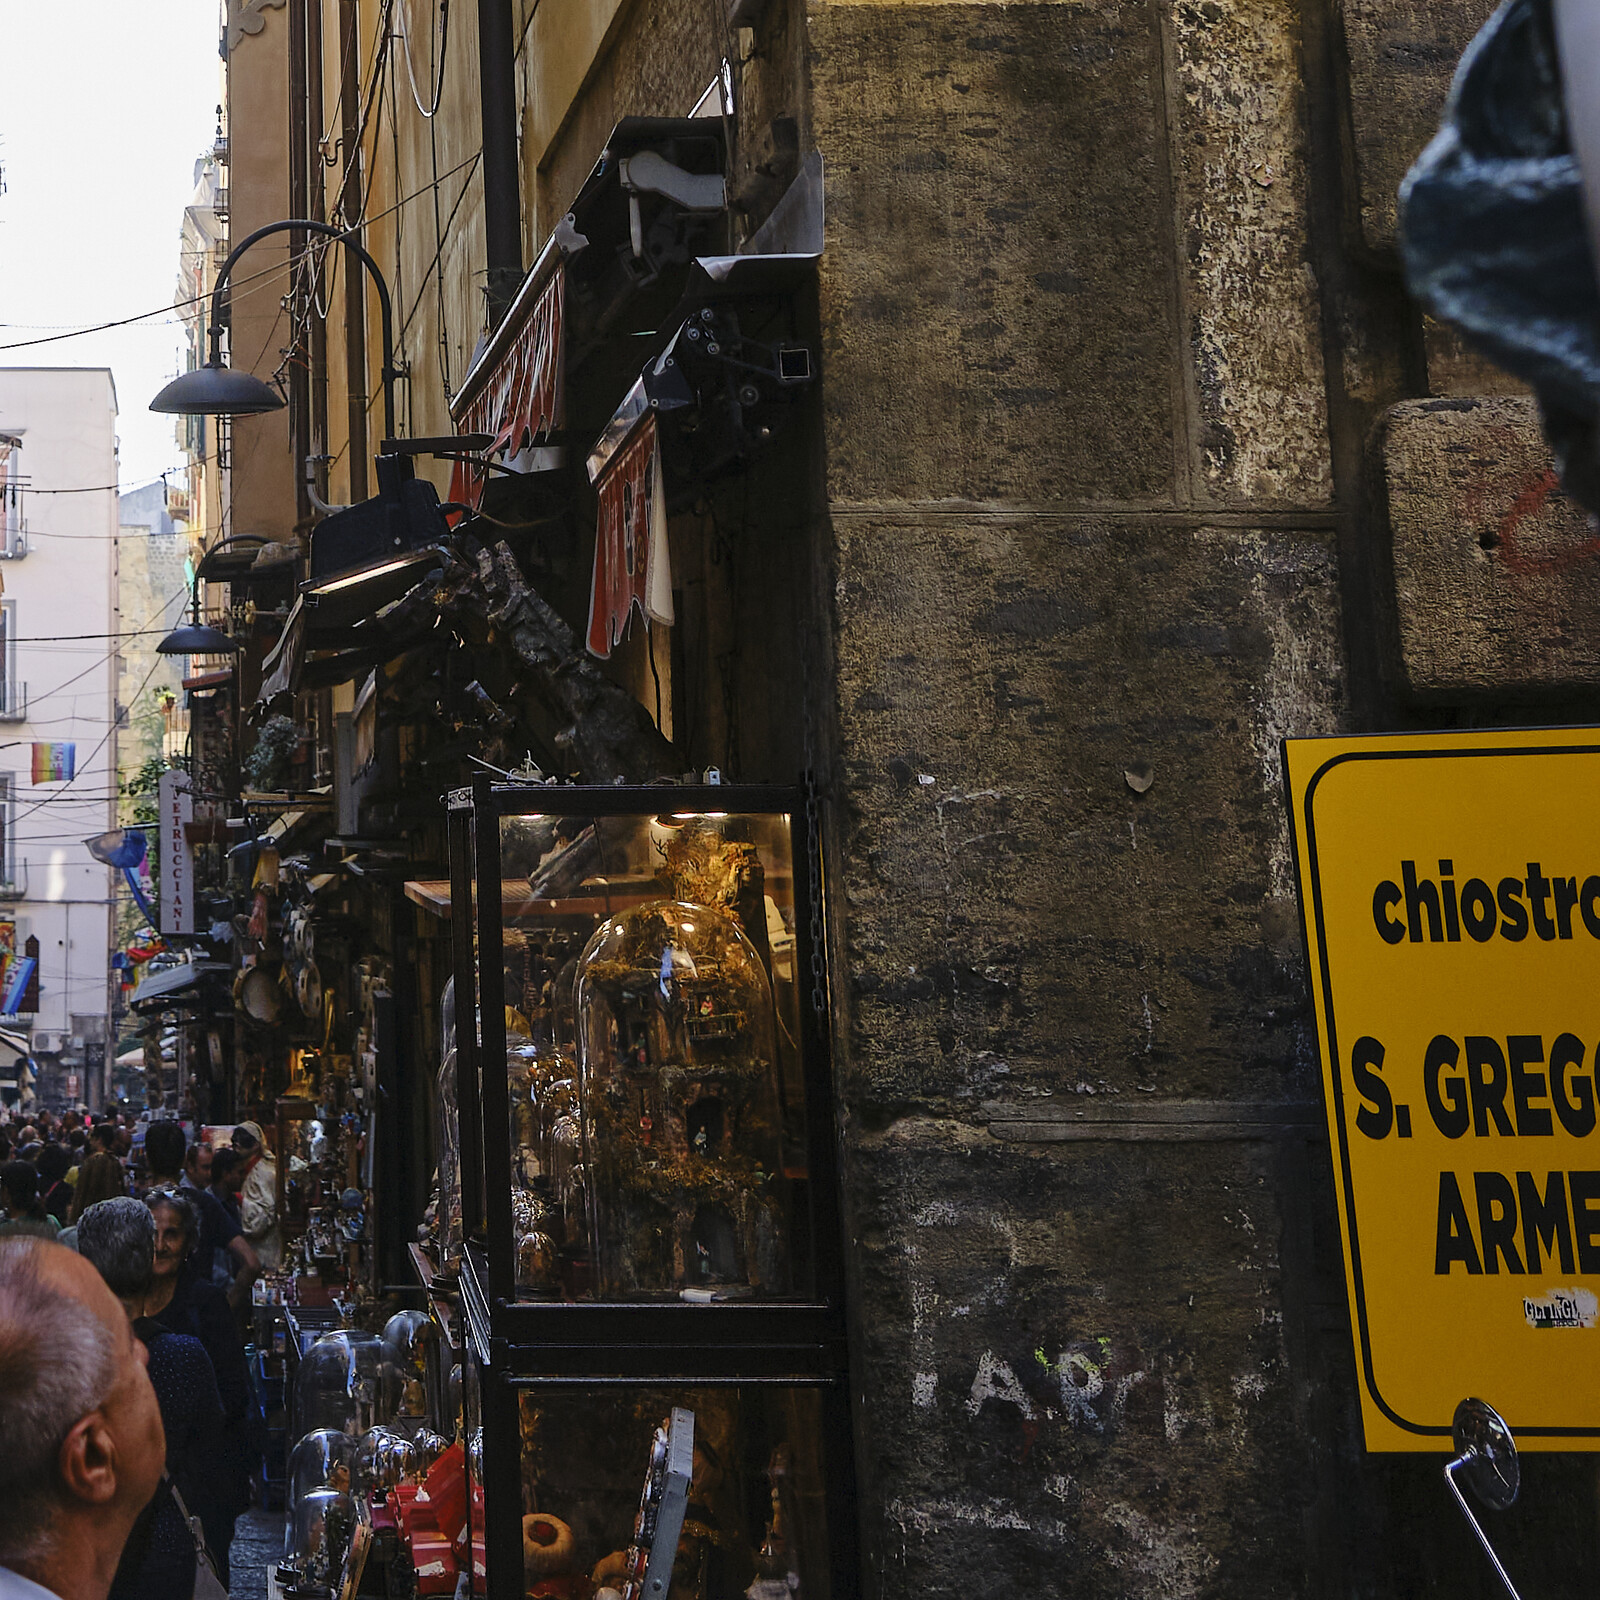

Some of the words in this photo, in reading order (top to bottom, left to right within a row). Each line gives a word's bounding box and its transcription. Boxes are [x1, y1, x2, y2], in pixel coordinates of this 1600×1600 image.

[1351, 1035, 1412, 1141] S.
[1423, 1033, 1600, 1139] GREG
[1434, 1170, 1600, 1276] ARME
